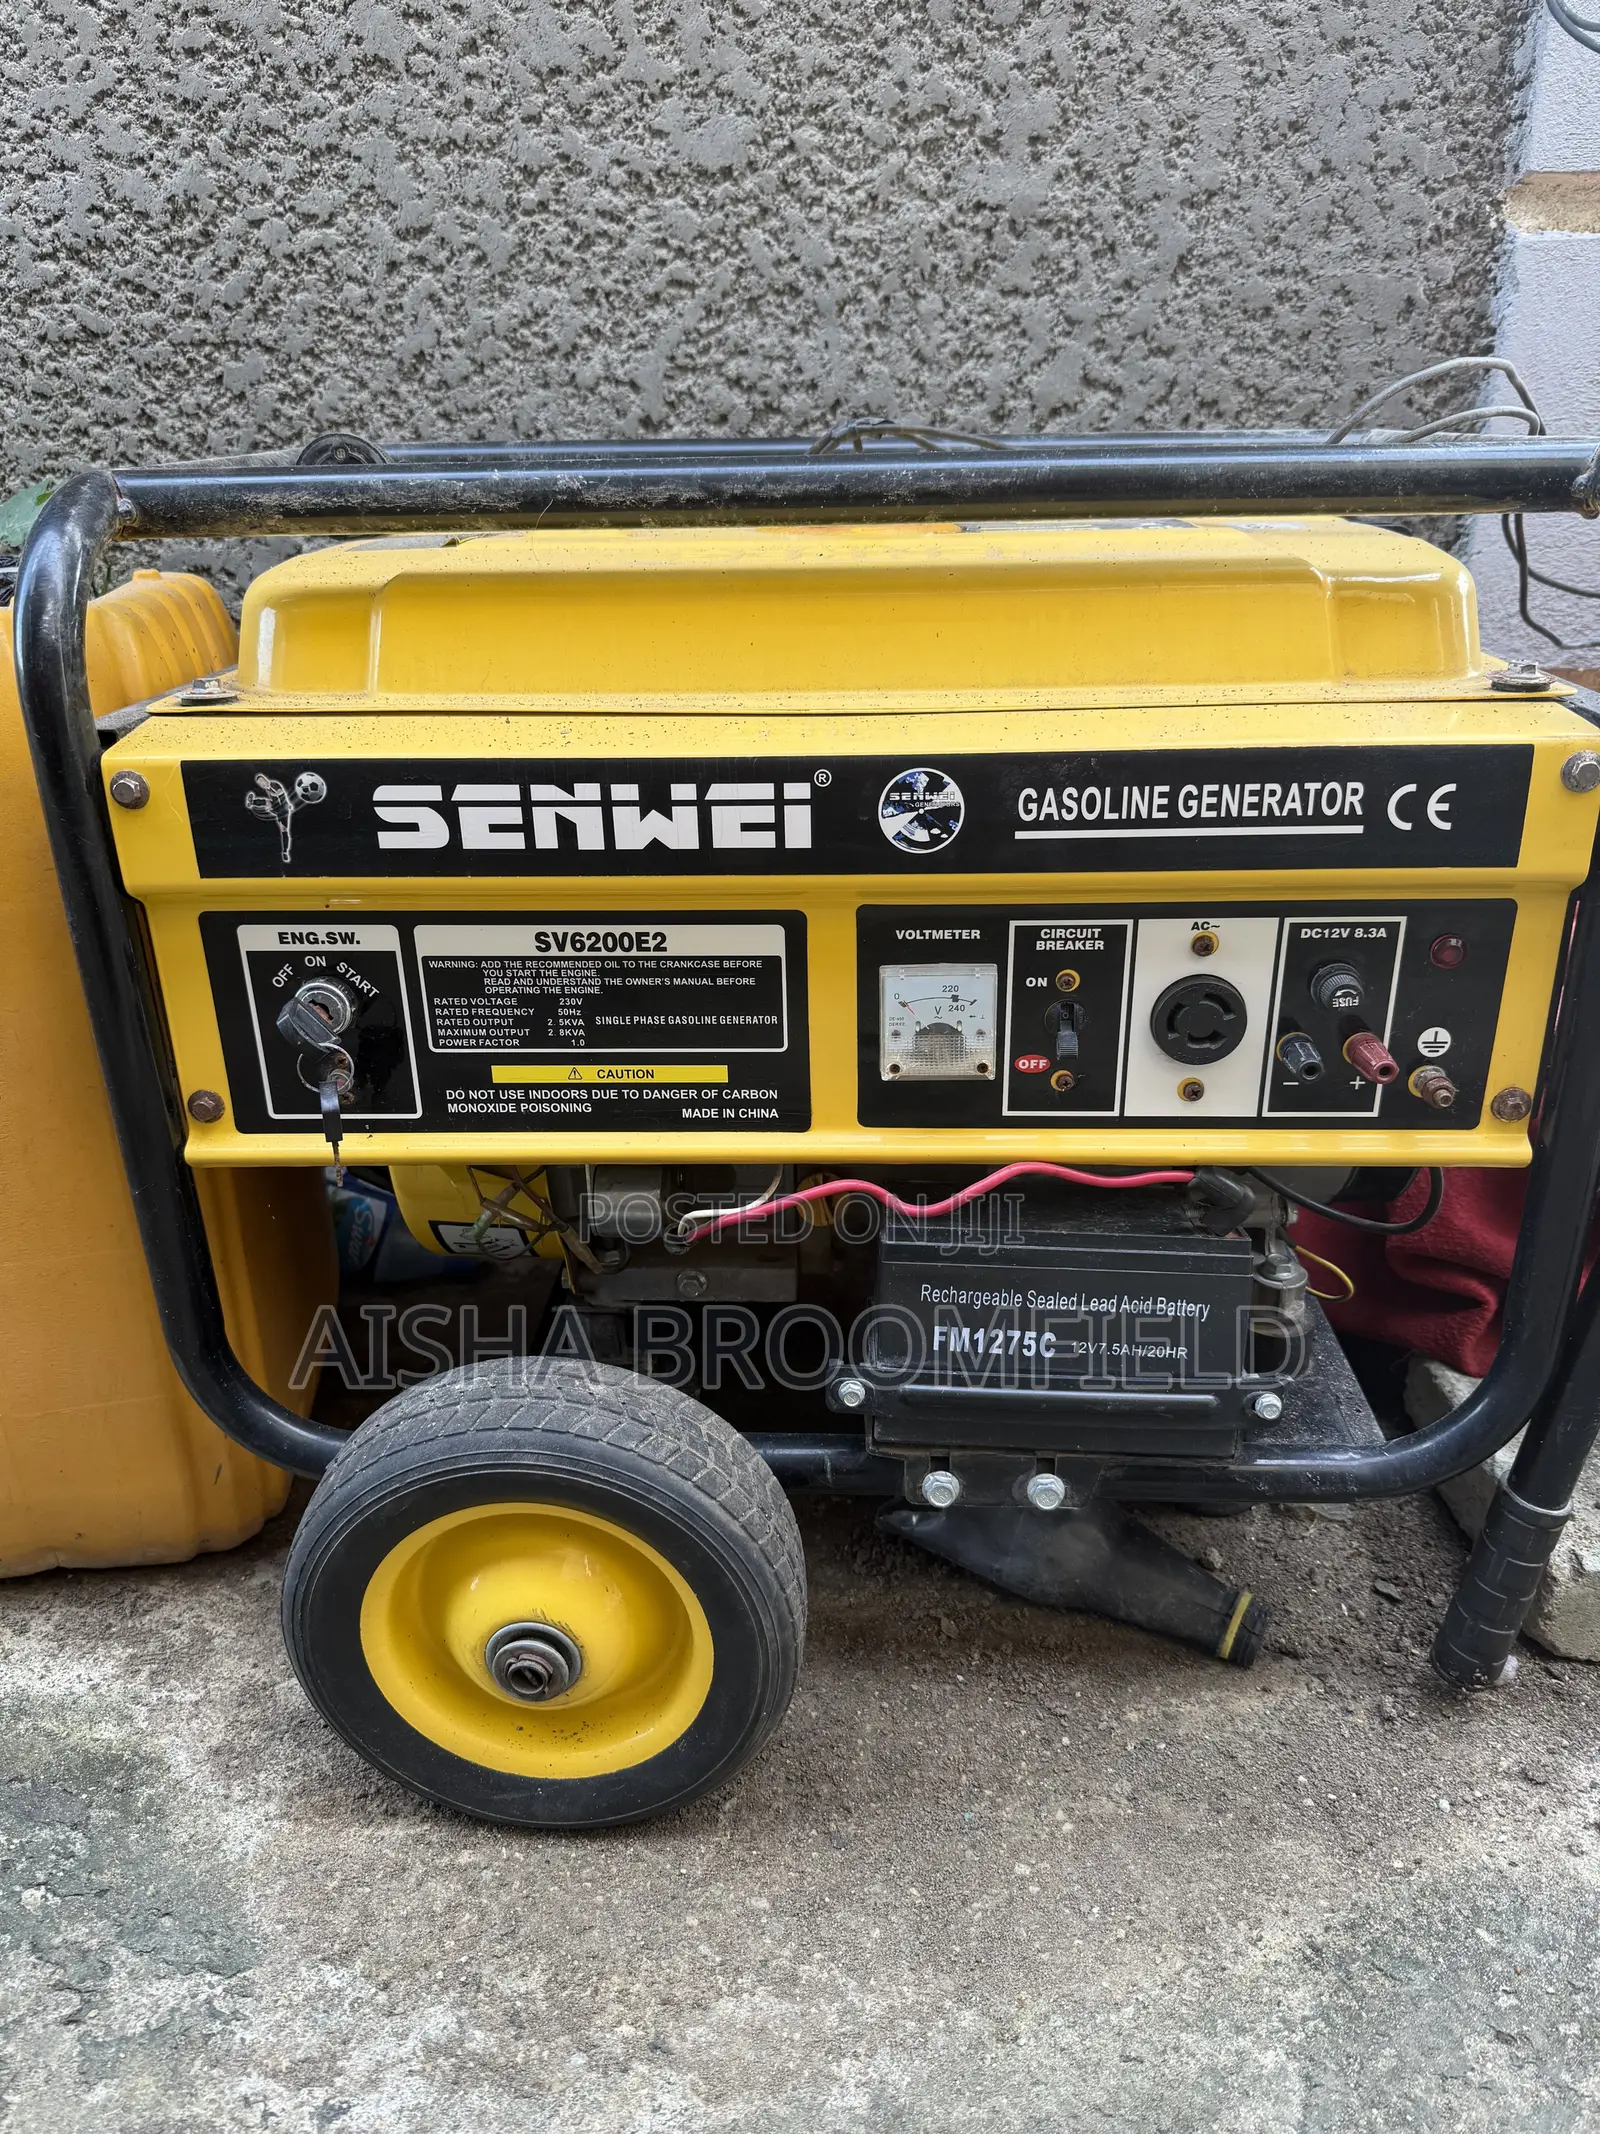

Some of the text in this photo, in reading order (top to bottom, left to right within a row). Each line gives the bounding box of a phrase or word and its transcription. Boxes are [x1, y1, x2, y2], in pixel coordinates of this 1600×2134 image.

[889, 791, 955, 800] SENWEI
[1017, 782, 1364, 822] GASOLINE GENERATOR
[1387, 783, 1457, 831] CE
[372, 783, 812, 850] SENWEI
[895, 930, 981, 939] VOLTMETER
[1040, 929, 1101, 939] CIRCUIT
[1300, 928, 1387, 938] DC12V 8.3A
[278, 932, 360, 945] ENG.SW.
[534, 932, 667, 953] SV6200E2
[1036, 941, 1104, 950] BREAKER
[272, 956, 379, 999] OFF ON START
[1026, 978, 1047, 987] ON
[942, 985, 959, 993] 220
[559, 998, 583, 1006] 230V
[1332, 997, 1359, 1008] FUSE
[948, 1004, 965, 1012] 240
[595, 1016, 778, 1025] SINGLE PHASE GASOLINE GENERATOR
[1019, 1059, 1047, 1069] OFF
[597, 1069, 654, 1079] CAUTION
[446, 1090, 778, 1099] DO NOT USE INDOORS DUE TO DANGER OF CARBON
[448, 1103, 592, 1113] MONOXIDE POISONING
[682, 1108, 779, 1118] MADE IN CHINA
[921, 1284, 1210, 1321] Rechargeable Sealed Lead Acid Battery
[933, 1326, 1188, 1360] FM1275C 12V7.5AH/20HR
